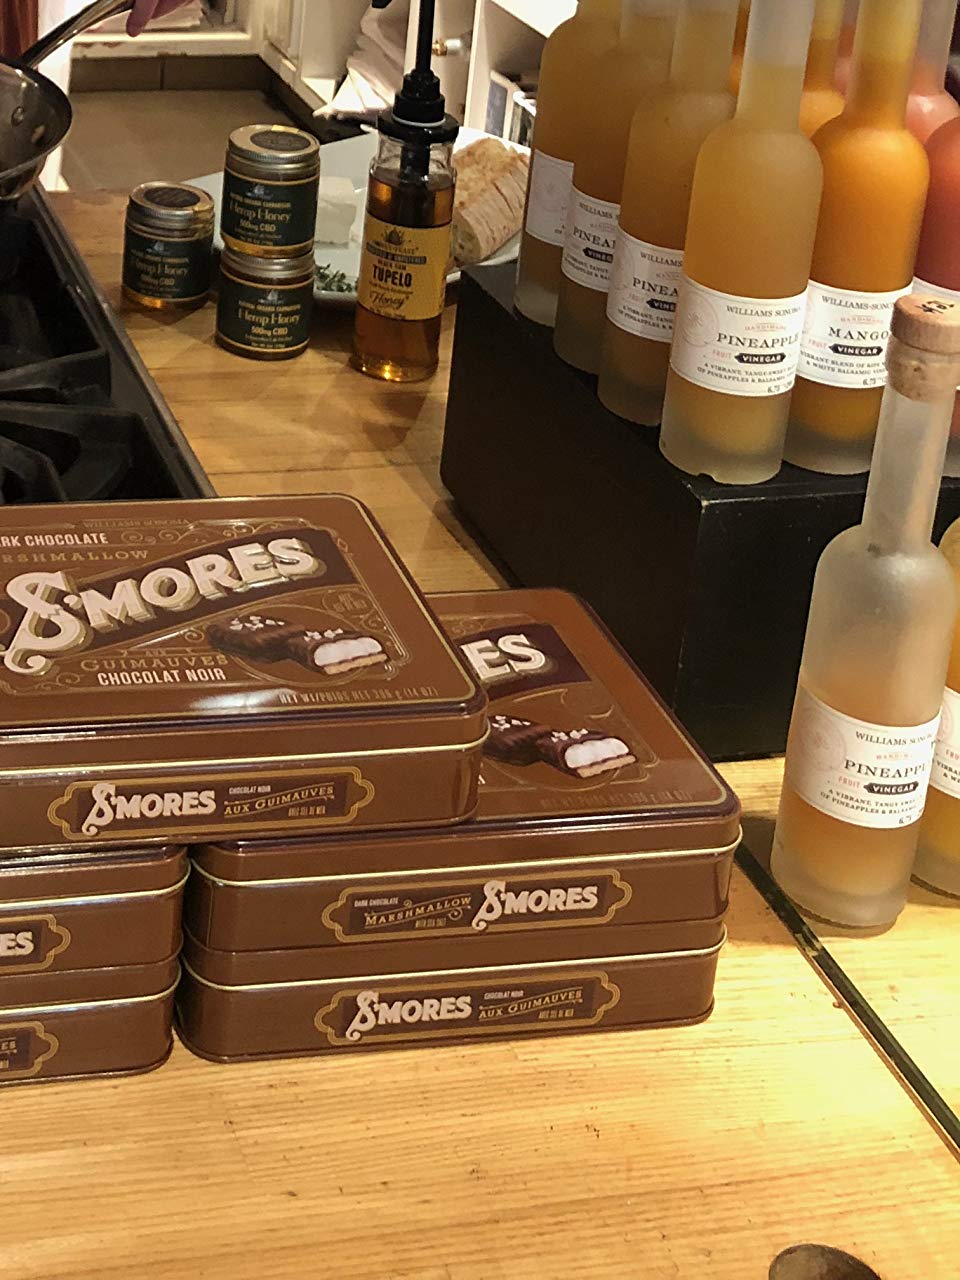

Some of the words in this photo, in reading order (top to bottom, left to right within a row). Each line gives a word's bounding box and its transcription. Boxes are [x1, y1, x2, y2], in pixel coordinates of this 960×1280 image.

[640, 251, 683, 268] WILLIAMS
[372, 263, 413, 288] TUPELO
[632, 276, 680, 298] PINEA
[726, 305, 774, 318] WILLIAMS
[716, 331, 800, 350] PINEAPPLE
[828, 326, 890, 341] MANGO
[741, 354, 782, 364] VINEGAR
[836, 345, 879, 356] VINEGAR
[706, 370, 749, 384] PINEAPPLES
[24, 532, 109, 547] CHOCOLATE
[80, 654, 229, 672] GUIMAUVES
[97, 669, 181, 686] CHOCOLAT
[188, 667, 227, 682] NOIR
[855, 730, 908, 746] WILLIAMS
[228, 786, 257, 795] CHOCOLAT
[838, 774, 861, 789] FRUIT
[872, 783, 916, 794] VINEGAR
[81, 782, 217, 837] S'MORES
[223, 803, 251, 816] AUX
[254, 785, 335, 810] GUIMAUVES
[820, 791, 830, 800] OF
[831, 797, 880, 815] PINEAPPLES
[353, 898, 369, 909] DARK
[369, 897, 400, 907] CHOCOLATE
[365, 895, 473, 926] MARSHMALLOW
[471, 879, 599, 931] S'MORES
[478, 1008, 504, 1021] AUX
[507, 988, 583, 1014] GUIMAUVES
[345, 990, 473, 1041] S'MORES
